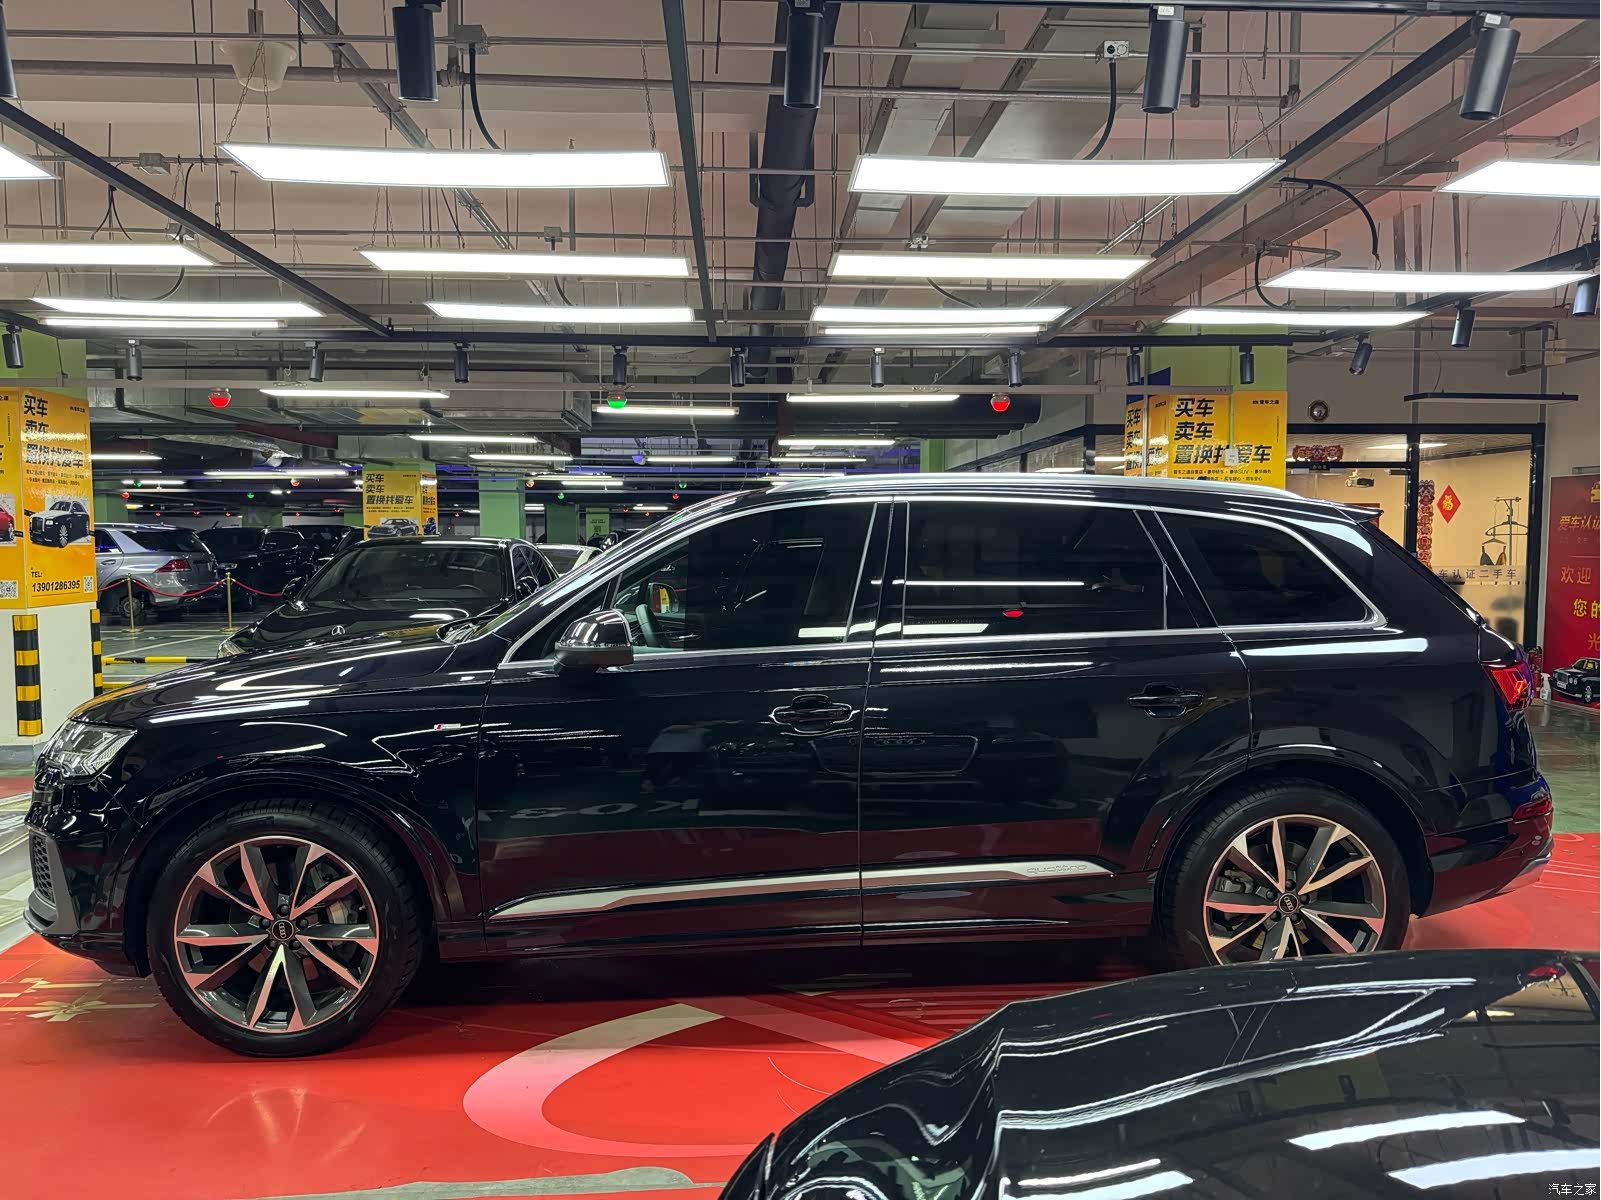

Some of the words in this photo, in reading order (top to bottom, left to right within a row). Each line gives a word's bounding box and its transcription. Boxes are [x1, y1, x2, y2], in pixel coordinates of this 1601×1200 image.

[24, 394, 48, 417] 买车
[1175, 397, 1215, 418] 买车
[1126, 407, 1142, 428] 买车
[1174, 421, 1215, 441] 卖车
[366, 473, 385, 483] 买车
[366, 484, 385, 494] 卖车
[366, 495, 414, 505] 置换找爱车
[1561, 566, 1592, 586] 欢迎
[32, 580, 81, 592] 13901286395
[1026, 864, 1088, 875] quattro
